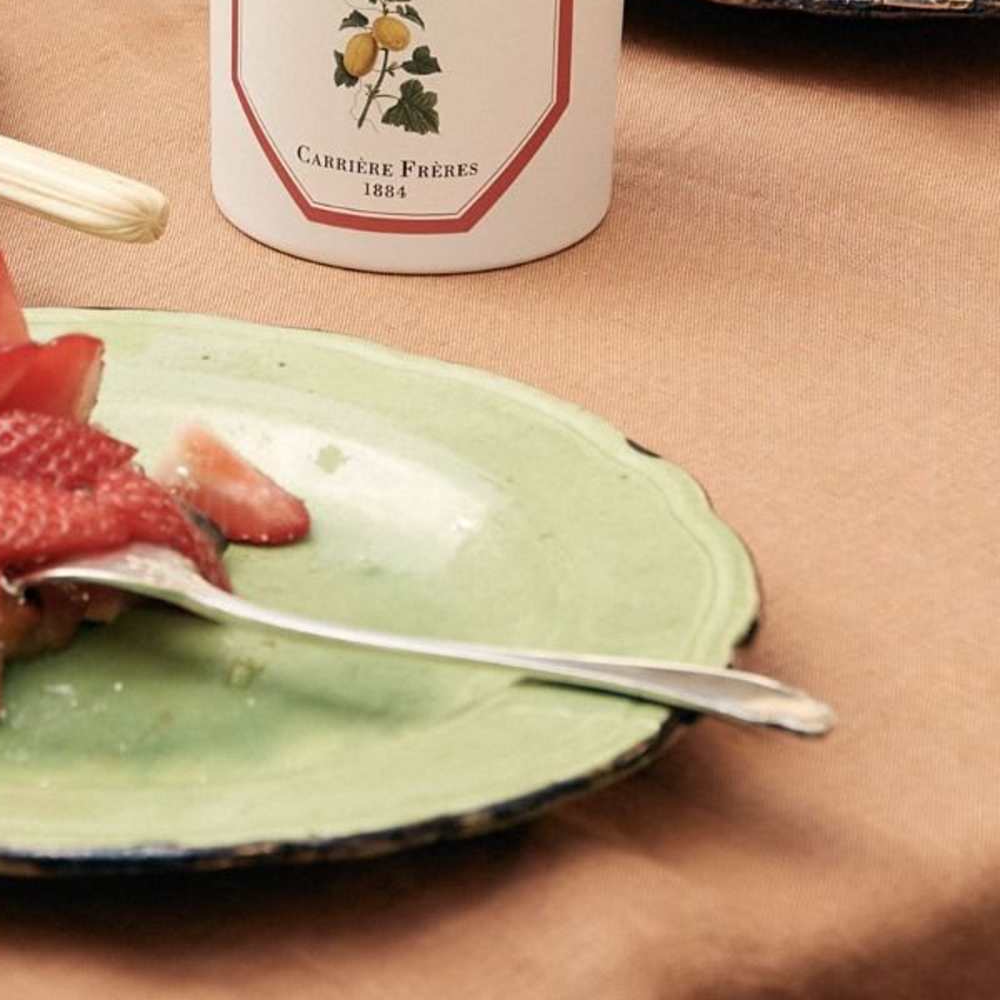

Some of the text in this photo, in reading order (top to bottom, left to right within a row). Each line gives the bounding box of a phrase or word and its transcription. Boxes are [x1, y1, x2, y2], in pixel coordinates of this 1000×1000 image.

[296, 144, 479, 179] CARRIÈRE FRÈRES
[364, 181, 407, 199] 1884
